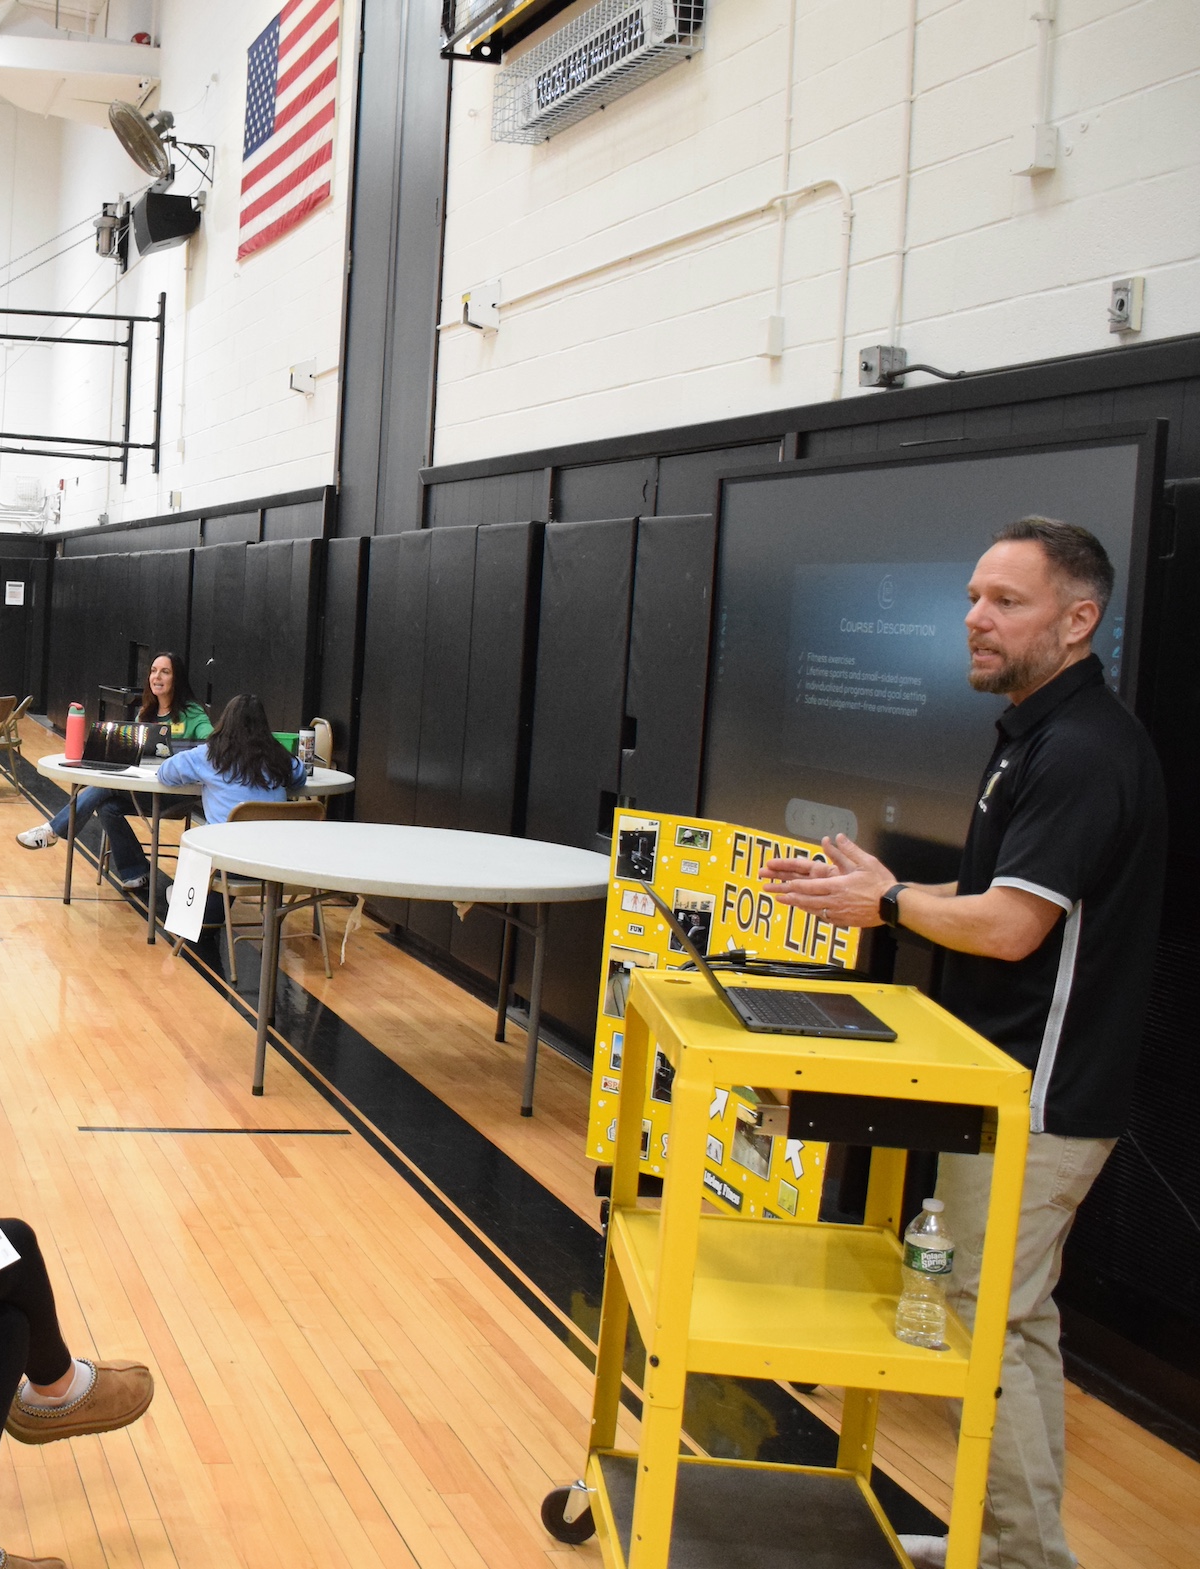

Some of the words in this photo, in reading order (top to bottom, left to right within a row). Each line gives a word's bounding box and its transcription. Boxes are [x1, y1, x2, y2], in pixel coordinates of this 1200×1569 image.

[807, 651, 828, 663] Fitness
[827, 656, 856, 665] exercises
[806, 665, 829, 677] Lifetime
[829, 669, 849, 680] sports
[848, 669, 861, 680] and
[861, 670, 898, 683] small-sided
[898, 676, 922, 687] games
[843, 686, 874, 698] programs
[874, 687, 887, 698] and
[887, 689, 902, 701] goal
[902, 691, 927, 705] setting
[804, 694, 818, 705] Safe
[817, 696, 828, 707] and
[876, 704, 918, 717] environment
[186, 886, 195, 907] 9
[721, 881, 775, 942] FOR
[629, 925, 643, 933] FUN
[921, 1250, 947, 1261] Poland
[921, 1258, 947, 1269] Spring
